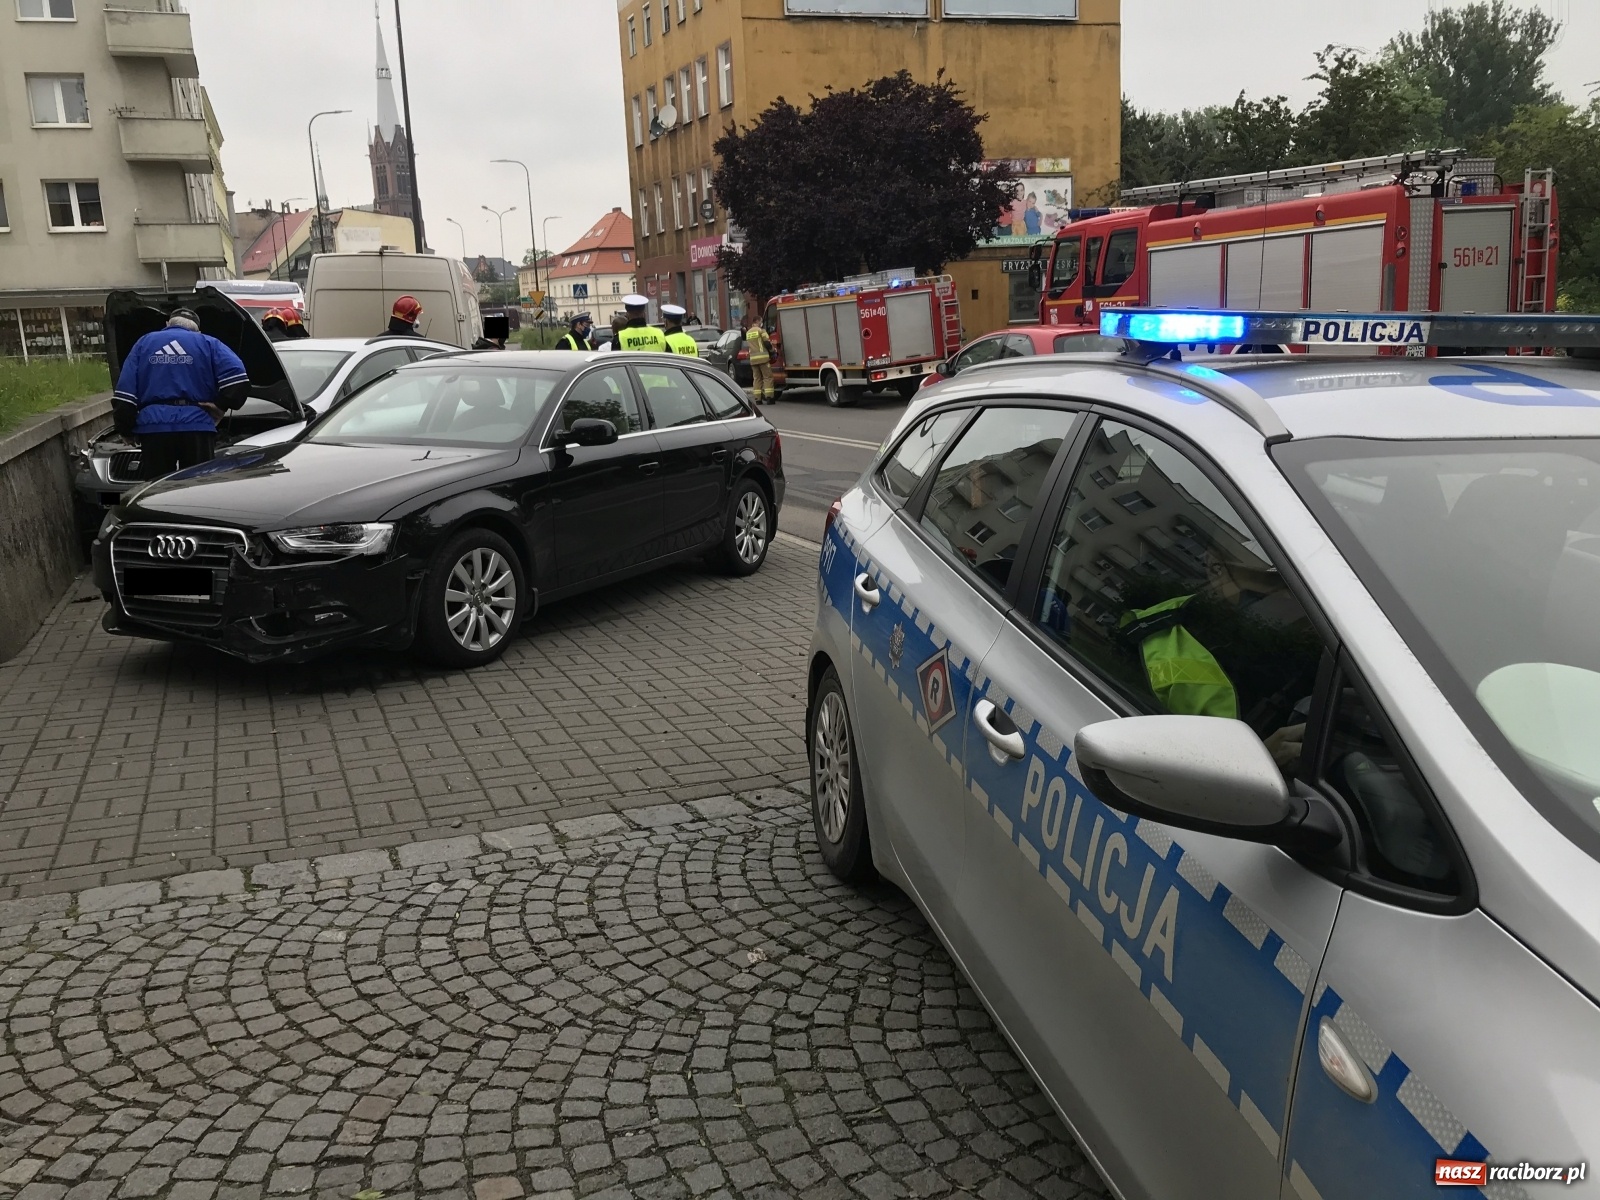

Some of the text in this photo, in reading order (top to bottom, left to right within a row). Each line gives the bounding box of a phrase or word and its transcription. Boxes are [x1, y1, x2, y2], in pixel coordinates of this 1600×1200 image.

[1002, 260, 1043, 271] FRYZJR
[1302, 321, 1424, 342] POLICJA
[627, 336, 659, 348] POLICJA
[678, 346, 696, 355] POLICJA
[149, 354, 193, 365] adidas
[929, 676, 940, 705] R
[1021, 753, 1180, 984] POLICJA
